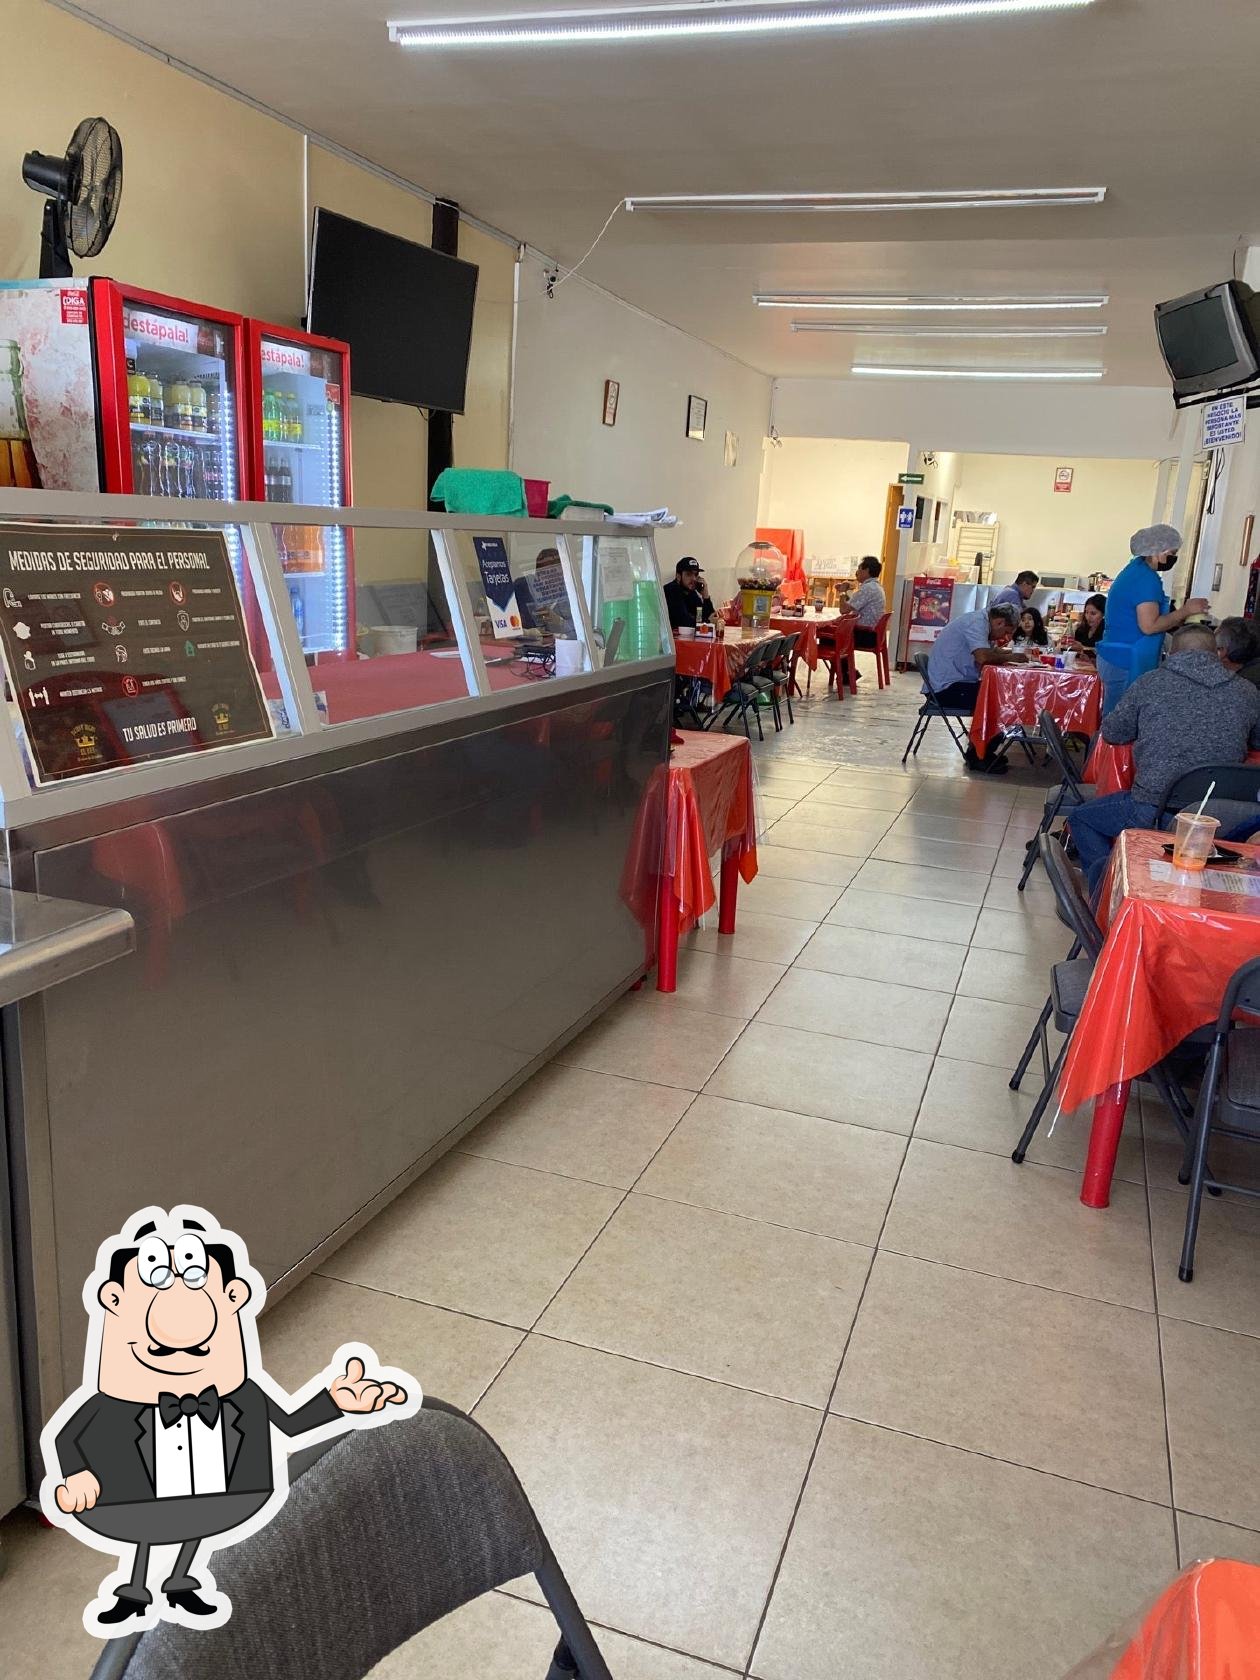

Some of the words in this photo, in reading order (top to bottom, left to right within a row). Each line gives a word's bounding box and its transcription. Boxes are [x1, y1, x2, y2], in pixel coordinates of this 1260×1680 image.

[8, 550, 57, 571] MEDIDAS
[57, 551, 74, 571] DE
[73, 551, 130, 571] SEGURIDAD
[129, 552, 157, 570] PARA
[155, 552, 169, 570] EL
[167, 552, 211, 569] PERSONAL
[482, 560, 507, 569] Aceptamos
[484, 571, 510, 586] Tarjetas
[495, 620, 508, 629] VISA
[122, 728, 134, 742] TU
[134, 724, 158, 740] SALUD
[157, 722, 167, 736] ES
[167, 717, 197, 735] PRIMERO
